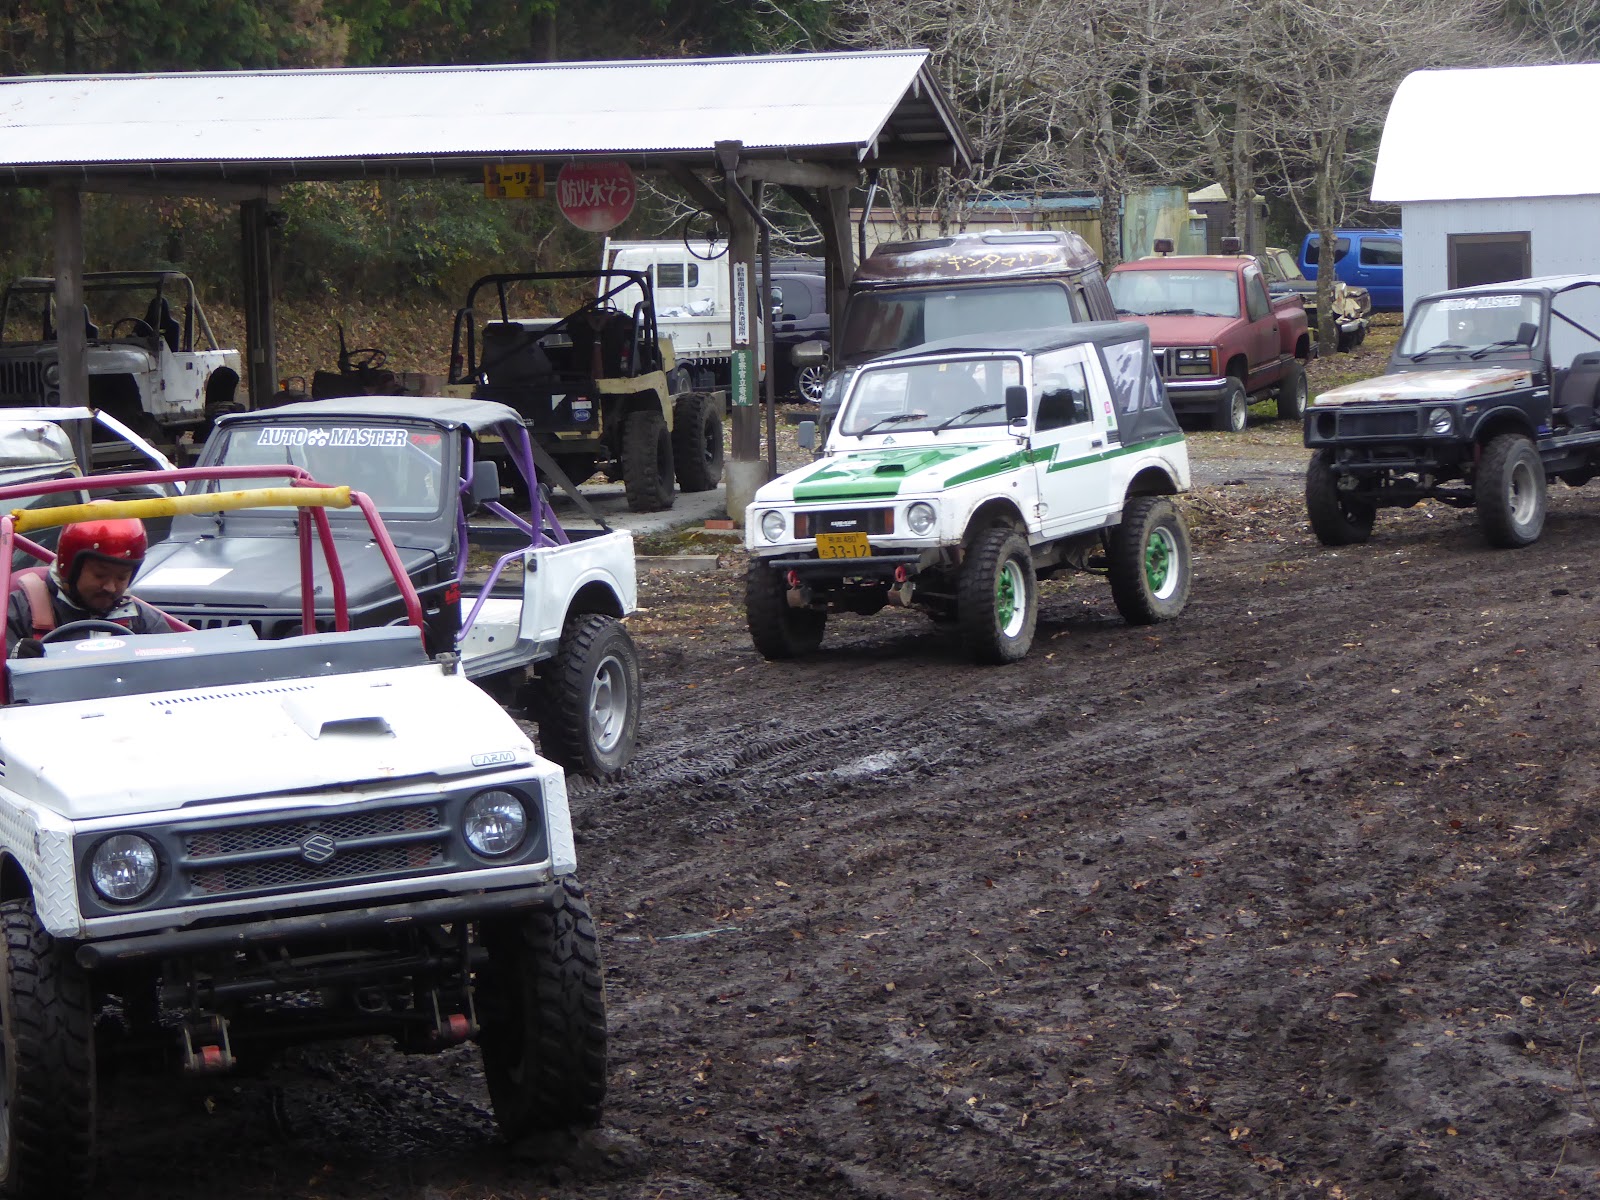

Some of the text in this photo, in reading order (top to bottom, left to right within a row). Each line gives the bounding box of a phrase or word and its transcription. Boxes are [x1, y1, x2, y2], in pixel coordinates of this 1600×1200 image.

[561, 177, 632, 208] 防火水そう
[738, 352, 747, 404] 警察官立寄所
[258, 428, 308, 445] AUTO
[329, 428, 408, 447] MASTER
